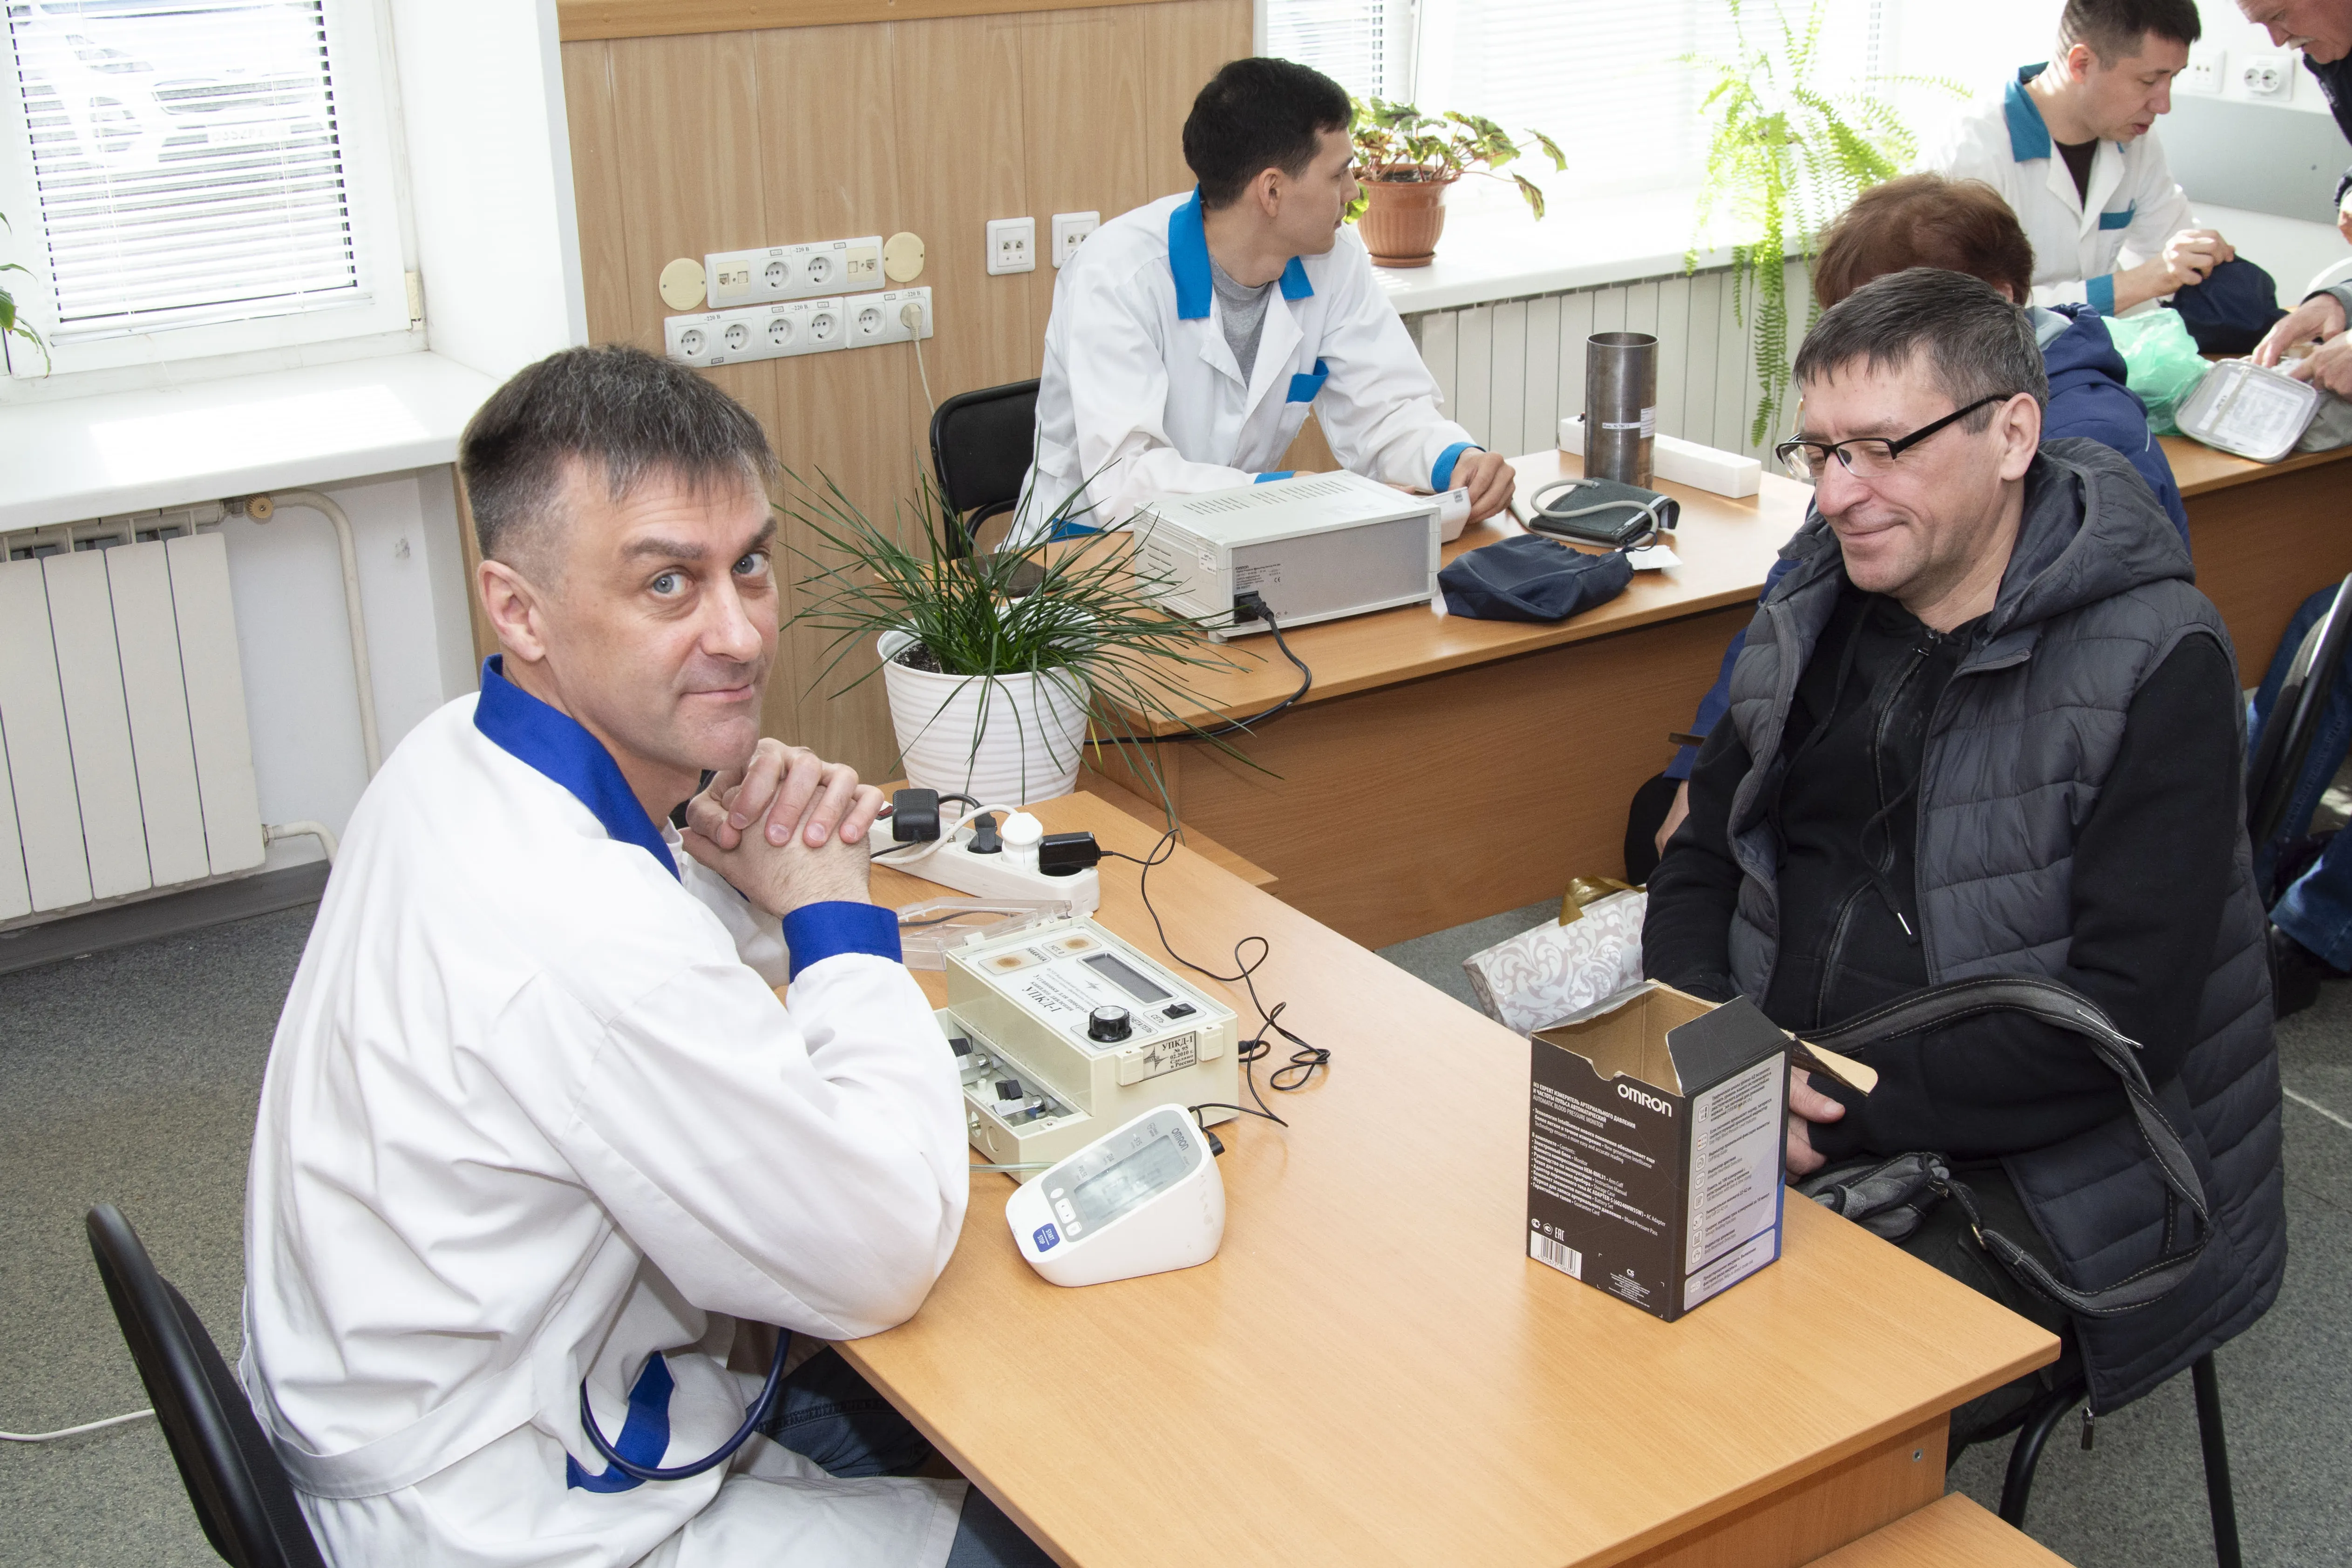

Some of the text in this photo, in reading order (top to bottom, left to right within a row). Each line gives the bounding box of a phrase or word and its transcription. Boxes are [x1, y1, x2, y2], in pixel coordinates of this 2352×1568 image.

[1026, 948, 1047, 962] НАКАЧКА
[1022, 986, 1062, 1012] УПКД-1
[1030, 981, 1051, 996] каналов
[1050, 995, 1074, 1012] давления
[1033, 974, 1060, 993] Установка
[1057, 991, 1068, 999] для
[1067, 997, 1089, 1013] поверки
[1129, 1015, 1153, 1033] ГНЕТАТЕЛЬ
[1150, 1014, 1165, 1024] СЕТЬ
[1162, 1036, 1192, 1051] УПКД-1
[1170, 1050, 1189, 1059] 02.2010
[1170, 1055, 1193, 1064] Сделано
[1175, 1059, 1194, 1067] России
[1533, 1093, 1604, 1129] AUTOMATIC BLOOD PRESSURE MONITOR
[1536, 1088, 1554, 1101] ЧАСТОТЫ
[1555, 1096, 1570, 1108] ПУЛЬСА
[1570, 1102, 1606, 1123] АВТОМАТИЧЕСКИЙ
[1539, 1084, 1554, 1095] EXPERT
[1554, 1090, 1580, 1106] ИЗМЕРИТЕЛЬ
[1580, 1100, 1613, 1120] АРТЕРИАЛЬНОГО
[1613, 1115, 1636, 1129] ДАВЛЕНИЯ
[1617, 1081, 1672, 1118] OMRON
[1133, 1137, 1142, 1147] SYS
[1171, 1128, 1189, 1151] OMRON
[1534, 1114, 1547, 1124] более
[1547, 1120, 1560, 1130] легкое
[1564, 1127, 1578, 1138] точное
[1578, 1133, 1601, 1147] измерение
[1612, 1148, 1631, 1161] generation
[1631, 1156, 1652, 1169] Intellisense
[1534, 1120, 1554, 1134] Technology
[1554, 1128, 1567, 1140] ensures
[1570, 1135, 1579, 1145] more
[1595, 1146, 1610, 1158] accurate
[1610, 1153, 1624, 1164] reading
[1535, 1107, 1655, 1163] Технология Intellisense нового поколения обеспечивает еще
[1535, 1133, 1557, 1147] комплекте
[1533, 1144, 1551, 1157] Манжета
[1551, 1152, 1584, 1171] компрессионная
[1584, 1166, 1606, 1181] HEM-RML31
[1534, 1139, 1588, 1167] Электронный блок Monitor
[1078, 1165, 1088, 1178] PULSE
[1533, 1151, 1559, 1167] Руководство
[1565, 1164, 1592, 1181] эксплуатации
[1594, 1177, 1613, 1191] Instruction
[1613, 1186, 1627, 1197] Manual
[1533, 1157, 1545, 1168] Чехол
[1554, 1166, 1573, 1180] хранения
[1573, 1174, 1591, 1188] прибора
[1593, 1183, 1607, 1195] Storage
[1607, 1189, 1615, 1198] Case
[1532, 1181, 1600, 1216] Гарантийный талон Guarantee Card
[1533, 1169, 1552, 1183] Комплект
[1553, 1178, 1574, 1193] элементов
[1574, 1188, 1592, 1200] питания
[1594, 1196, 1607, 1207] Battery
[1533, 1163, 1550, 1176] Адаптер
[1550, 1171, 1577, 1188] переменного
[1577, 1182, 1586, 1192] тока
[1592, 1189, 1613, 1203] ADAPTER-S
[1651, 1215, 1665, 1227] Adapter
[1533, 1175, 1548, 1188] Журнал
[1557, 1186, 1570, 1198] записи
[1571, 1192, 1601, 1211] артериального
[1601, 1206, 1621, 1220] давления
[1624, 1215, 1634, 1226] Blood
[1635, 1221, 1650, 1233] Pressure
[1650, 1227, 1658, 1236] Pass
[1037, 1235, 1046, 1244] STOP
[1046, 1229, 1055, 1241] START
[1554, 1226, 1564, 1242] EAC
[1626, 1268, 1634, 1277] CS
